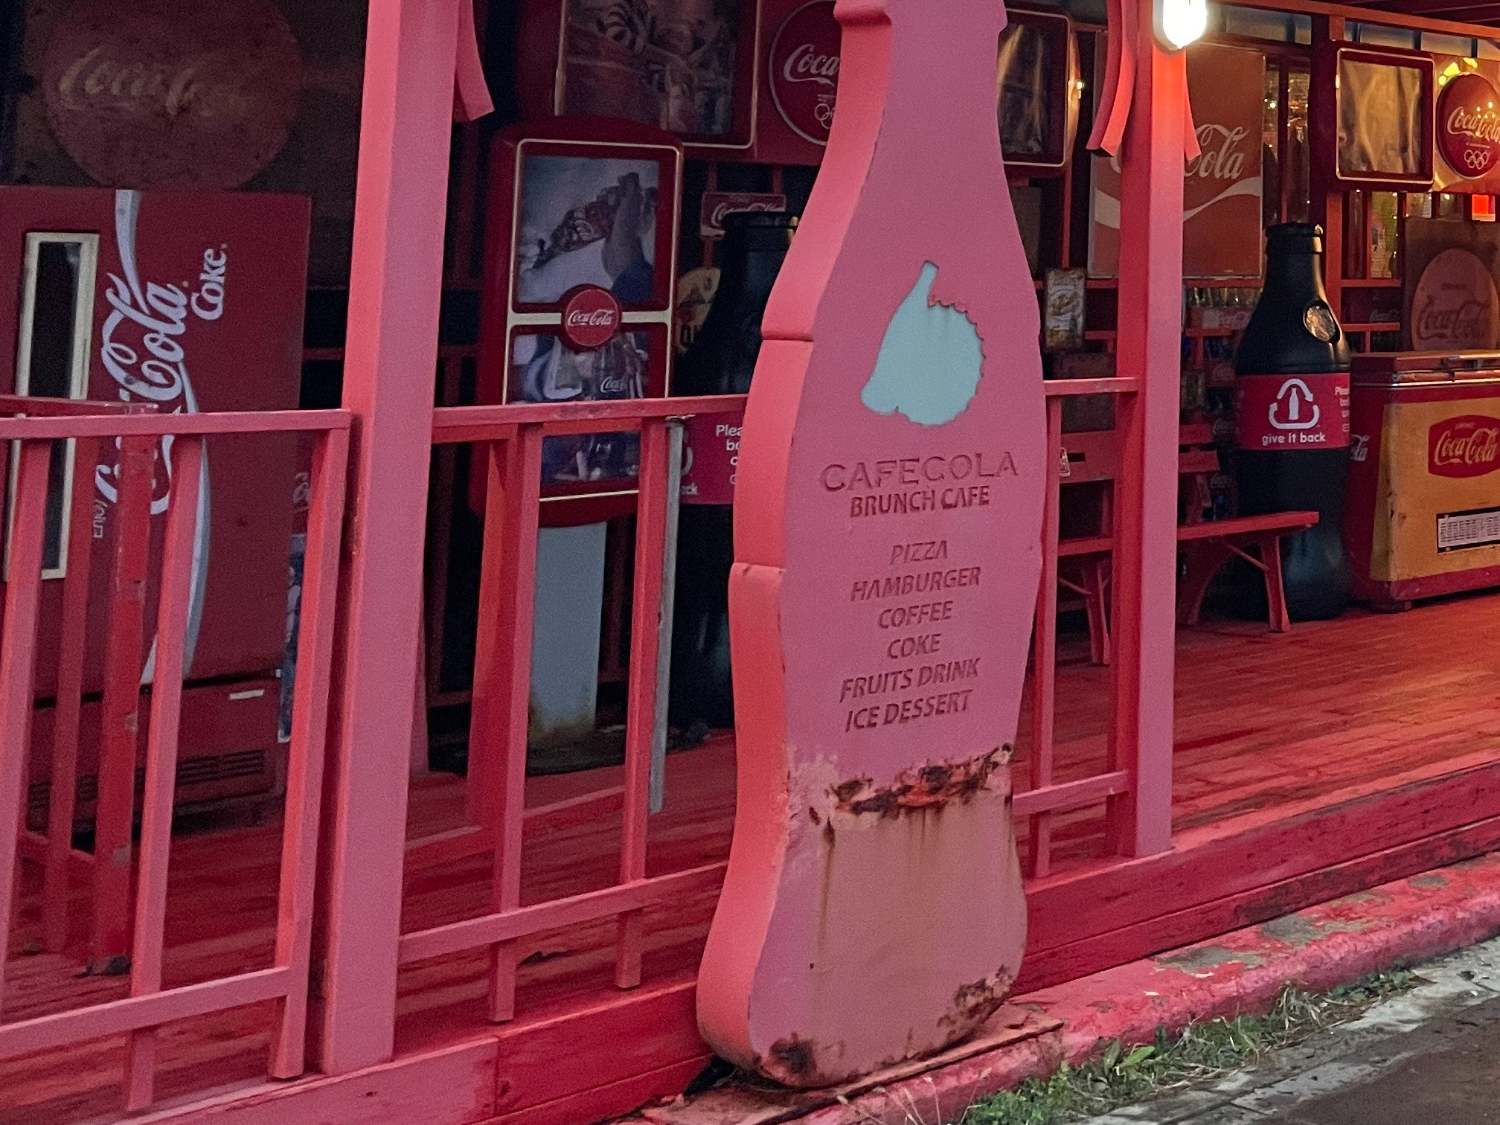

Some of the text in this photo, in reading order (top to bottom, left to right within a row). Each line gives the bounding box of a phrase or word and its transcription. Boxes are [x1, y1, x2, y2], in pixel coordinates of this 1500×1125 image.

[190, 246, 227, 321] Coke
[567, 309, 616, 327] Coca-Cola
[1261, 431, 1327, 447] give it back
[1434, 427, 1500, 466] Coca-Cola
[820, 451, 1018, 492] CAFECOLA
[850, 485, 990, 518] BRUNCH CAFE
[890, 540, 948, 565] PIZZA
[850, 567, 981, 602] HAMBURGER
[878, 601, 954, 629] COFFEE
[887, 633, 942, 659] COKE
[840, 657, 981, 704] FRUITS DRINK
[845, 689, 974, 733] ICE DESSERT
